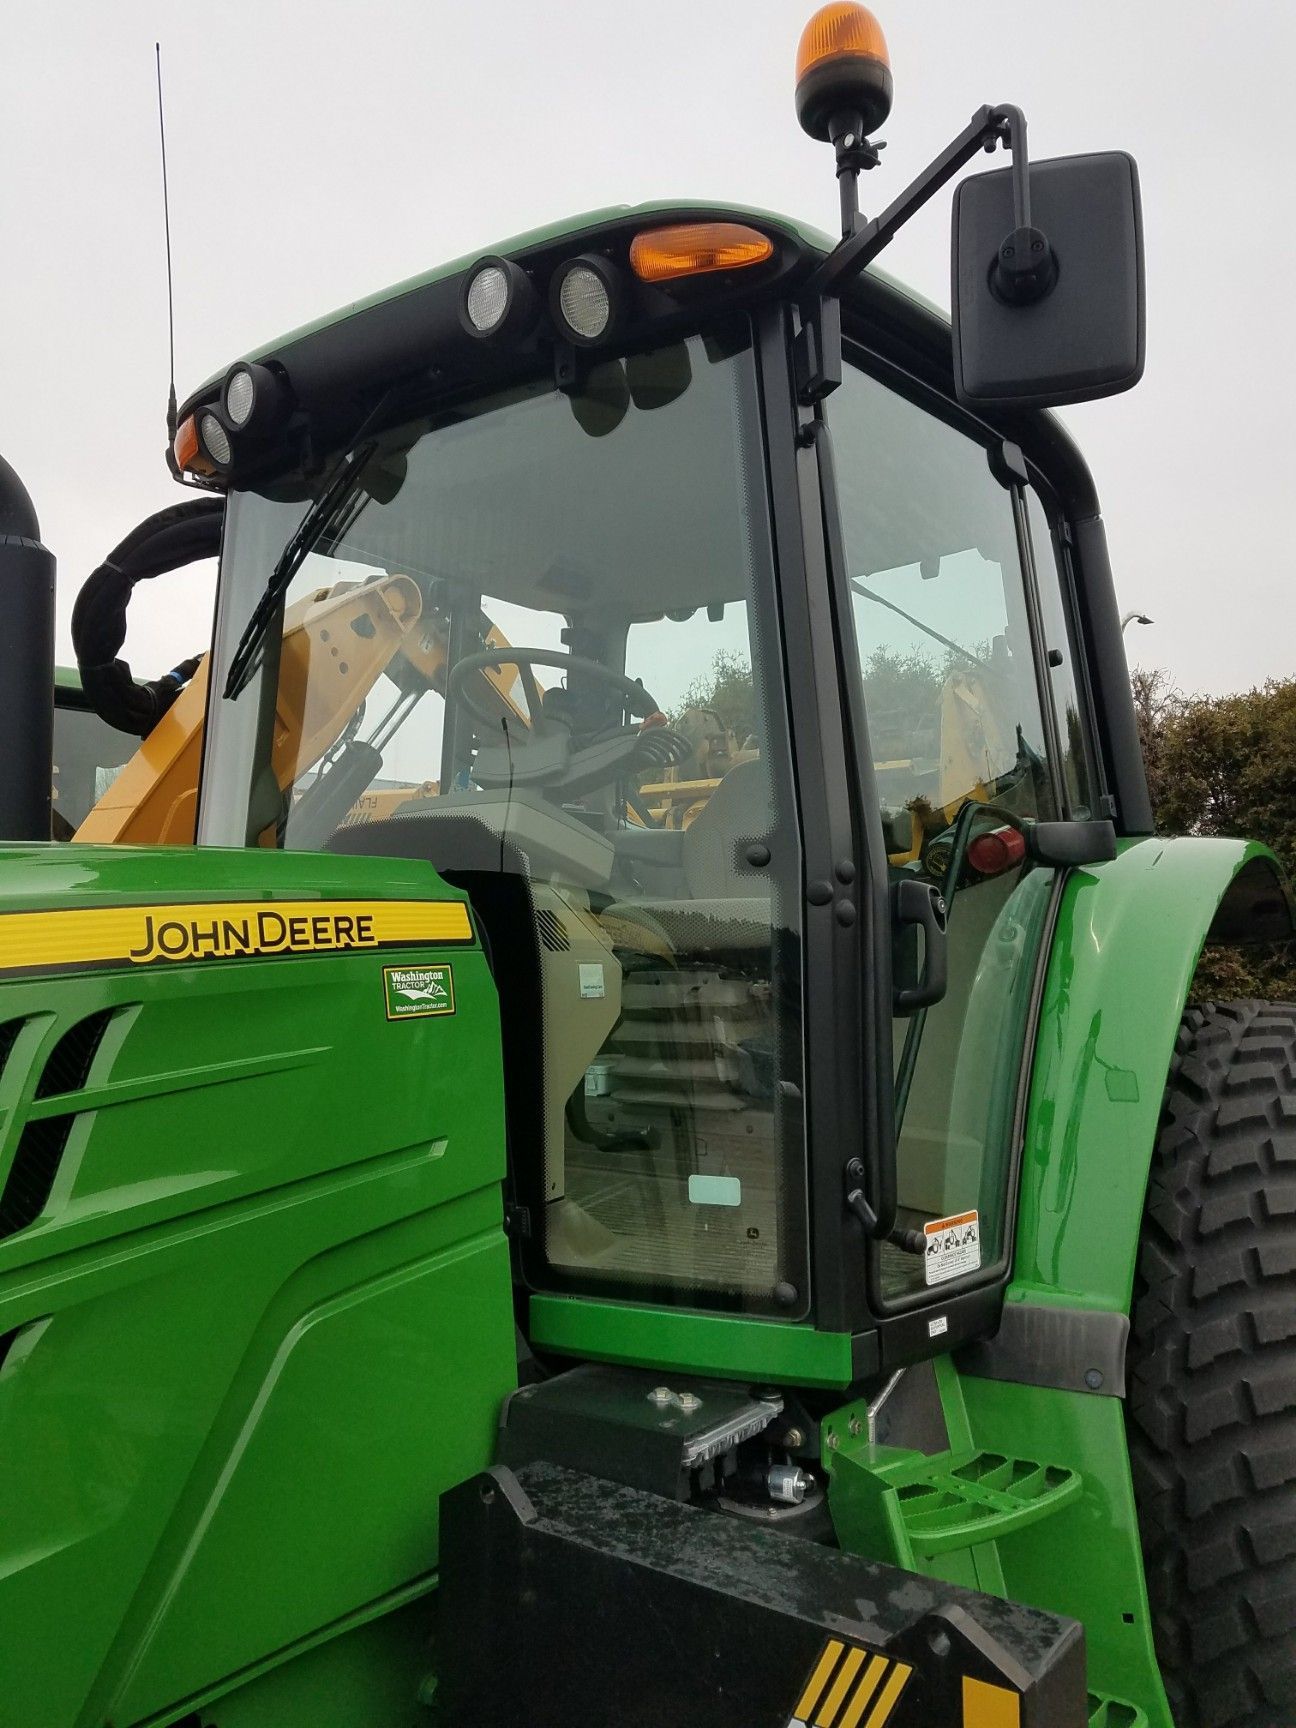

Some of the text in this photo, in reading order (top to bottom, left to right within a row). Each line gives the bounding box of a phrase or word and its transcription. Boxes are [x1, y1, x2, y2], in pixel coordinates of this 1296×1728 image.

[130, 911, 376, 958] JOHN DEERE
[391, 970, 443, 983] Washington
[392, 981, 425, 990] TRACTOR
